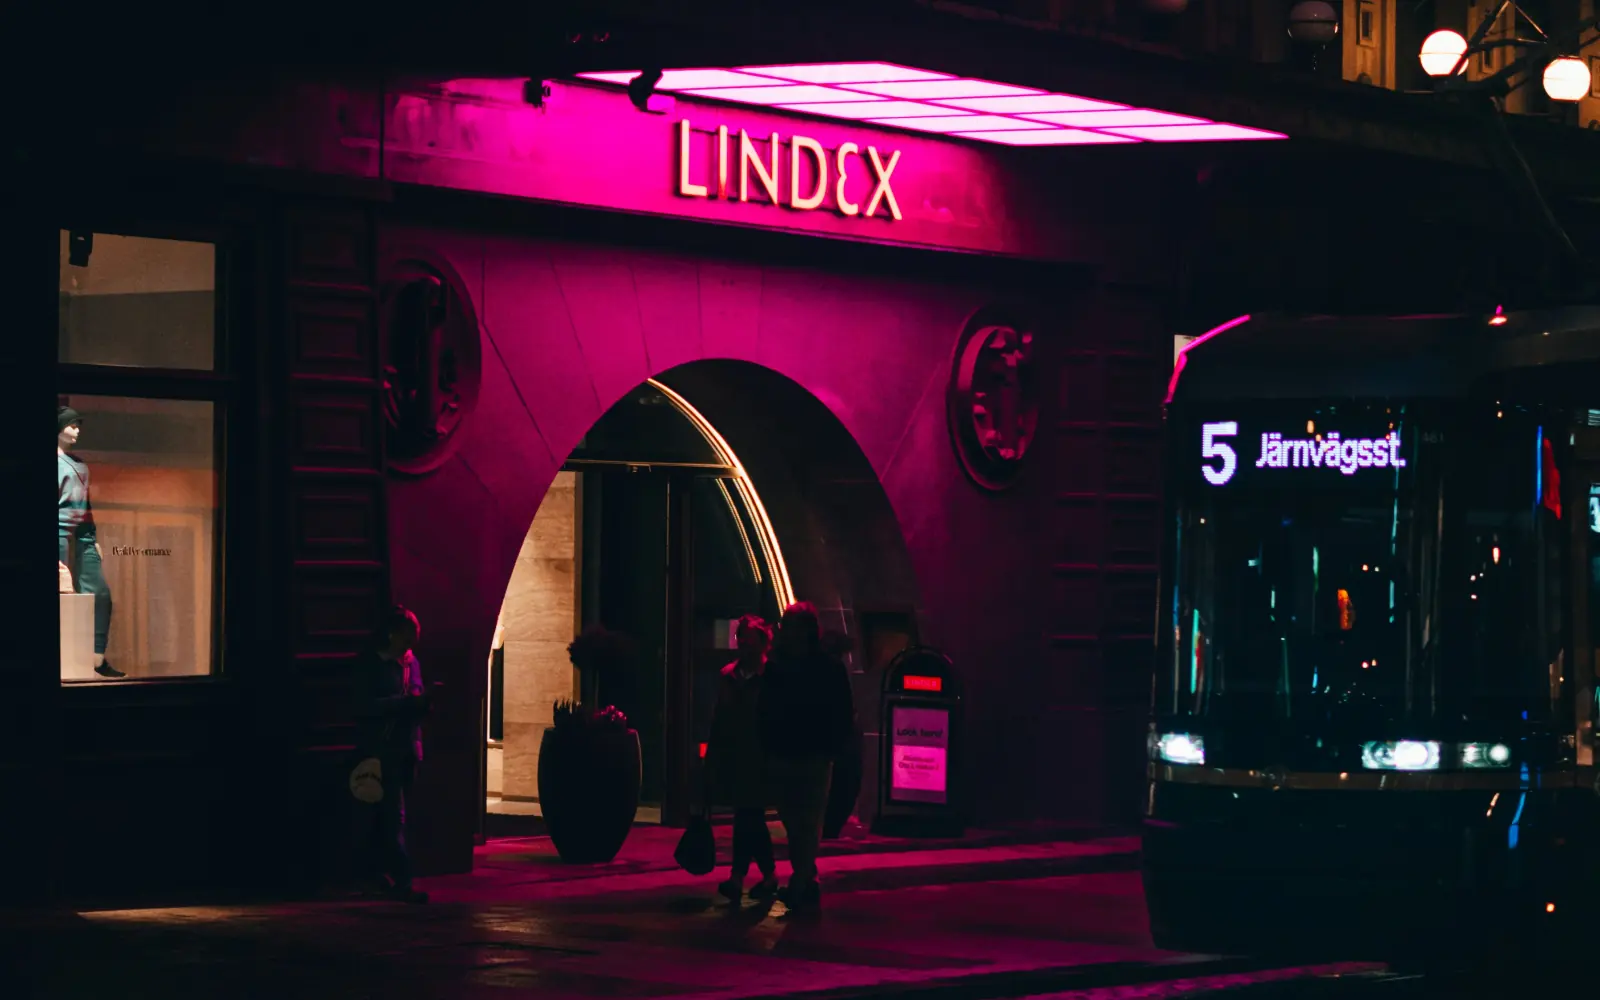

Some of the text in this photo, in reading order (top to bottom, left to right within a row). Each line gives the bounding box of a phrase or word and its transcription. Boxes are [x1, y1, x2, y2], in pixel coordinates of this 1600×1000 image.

[680, 118, 903, 221] LINDEX
[1201, 421, 1406, 486] 5 Järnvägsst.
